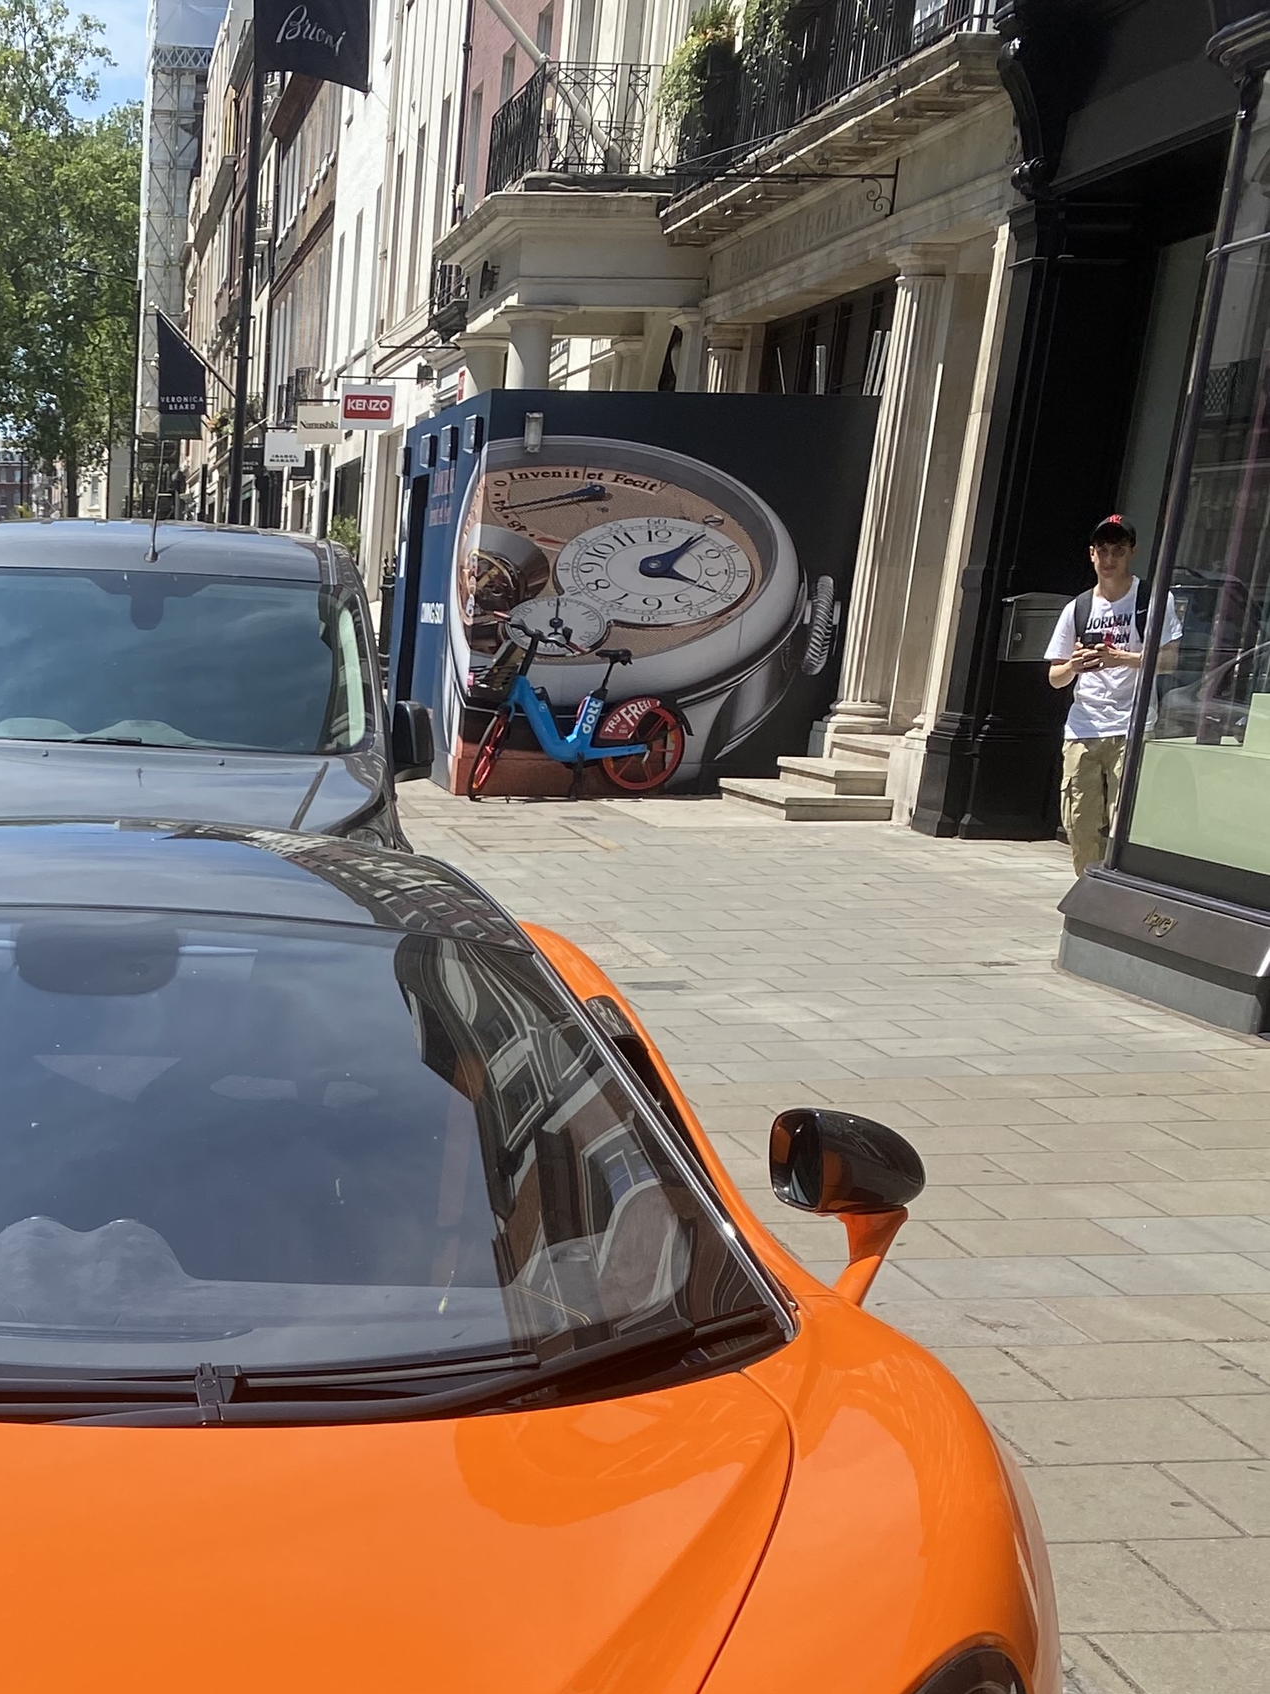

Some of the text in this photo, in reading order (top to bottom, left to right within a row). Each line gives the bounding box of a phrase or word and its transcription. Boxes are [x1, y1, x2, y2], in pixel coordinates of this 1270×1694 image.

[276, 4, 346, 57] Brioni
[803, 193, 866, 247] HOLLAN
[160, 395, 204, 403] VERONICA
[347, 399, 390, 411] KENZO
[507, 469, 659, 492] Invenit et Fecit
[647, 518, 667, 526] 60
[613, 532, 636, 547] 11
[647, 530, 672, 543] 12
[585, 542, 616, 560] 10
[697, 548, 721, 561] 2
[579, 561, 604, 574] 9
[585, 578, 611, 592] 8
[642, 596, 663, 610] 6
[1086, 613, 1133, 630] JORDAN
[582, 700, 602, 734] dott
[604, 714, 621, 733] TRY
[619, 700, 652, 727] FREE!
